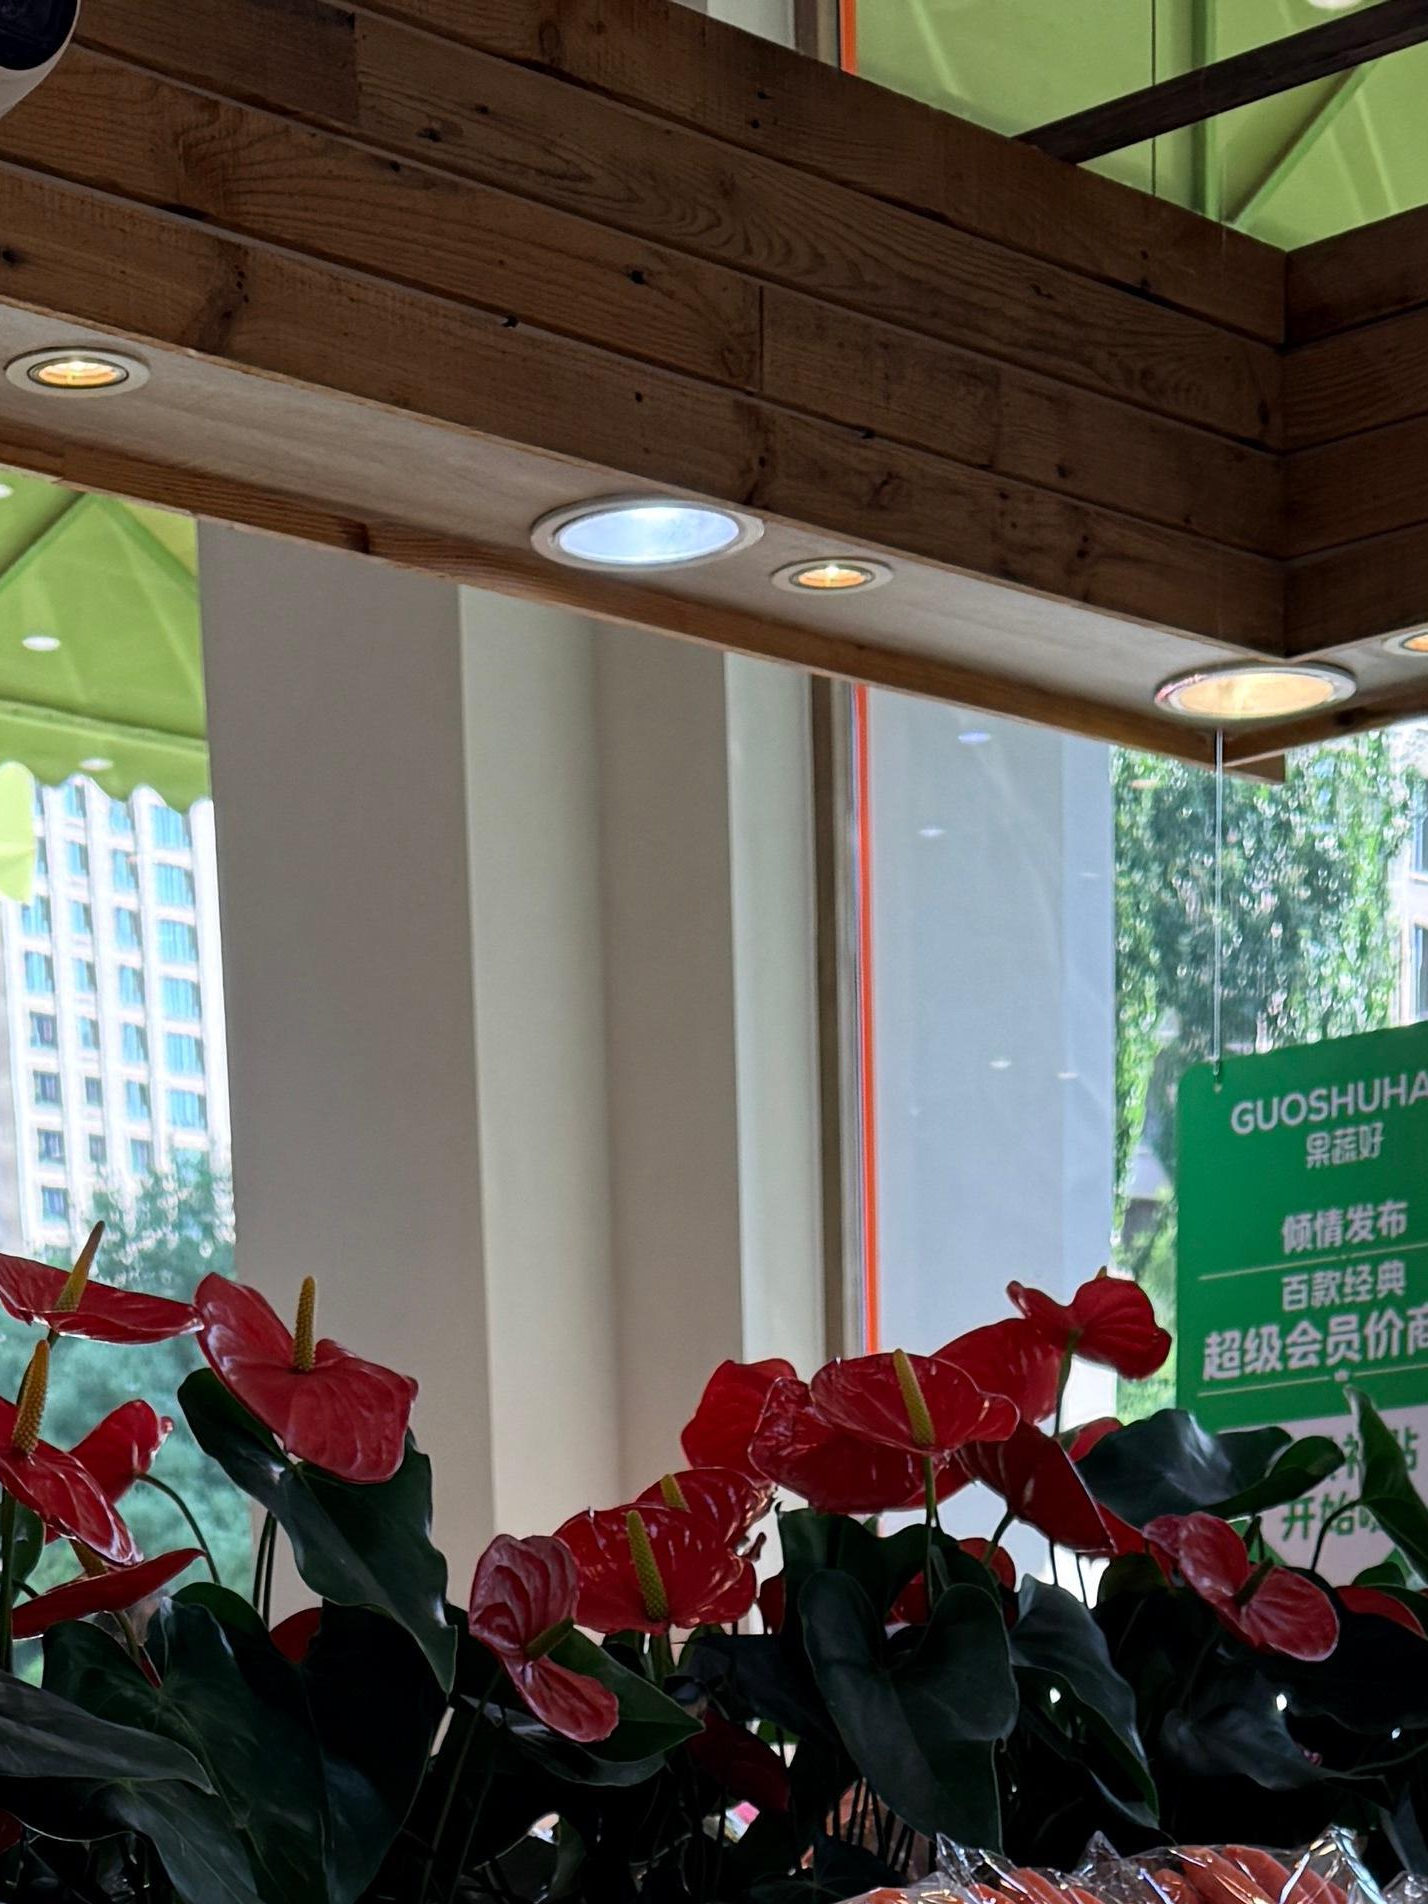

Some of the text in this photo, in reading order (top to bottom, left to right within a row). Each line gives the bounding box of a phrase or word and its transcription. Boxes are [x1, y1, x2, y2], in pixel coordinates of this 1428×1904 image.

[1305, 1122, 1385, 1169] 果蔬好
[1281, 1200, 1409, 1256] 倾情发布
[1280, 1259, 1408, 1312] 百款经典
